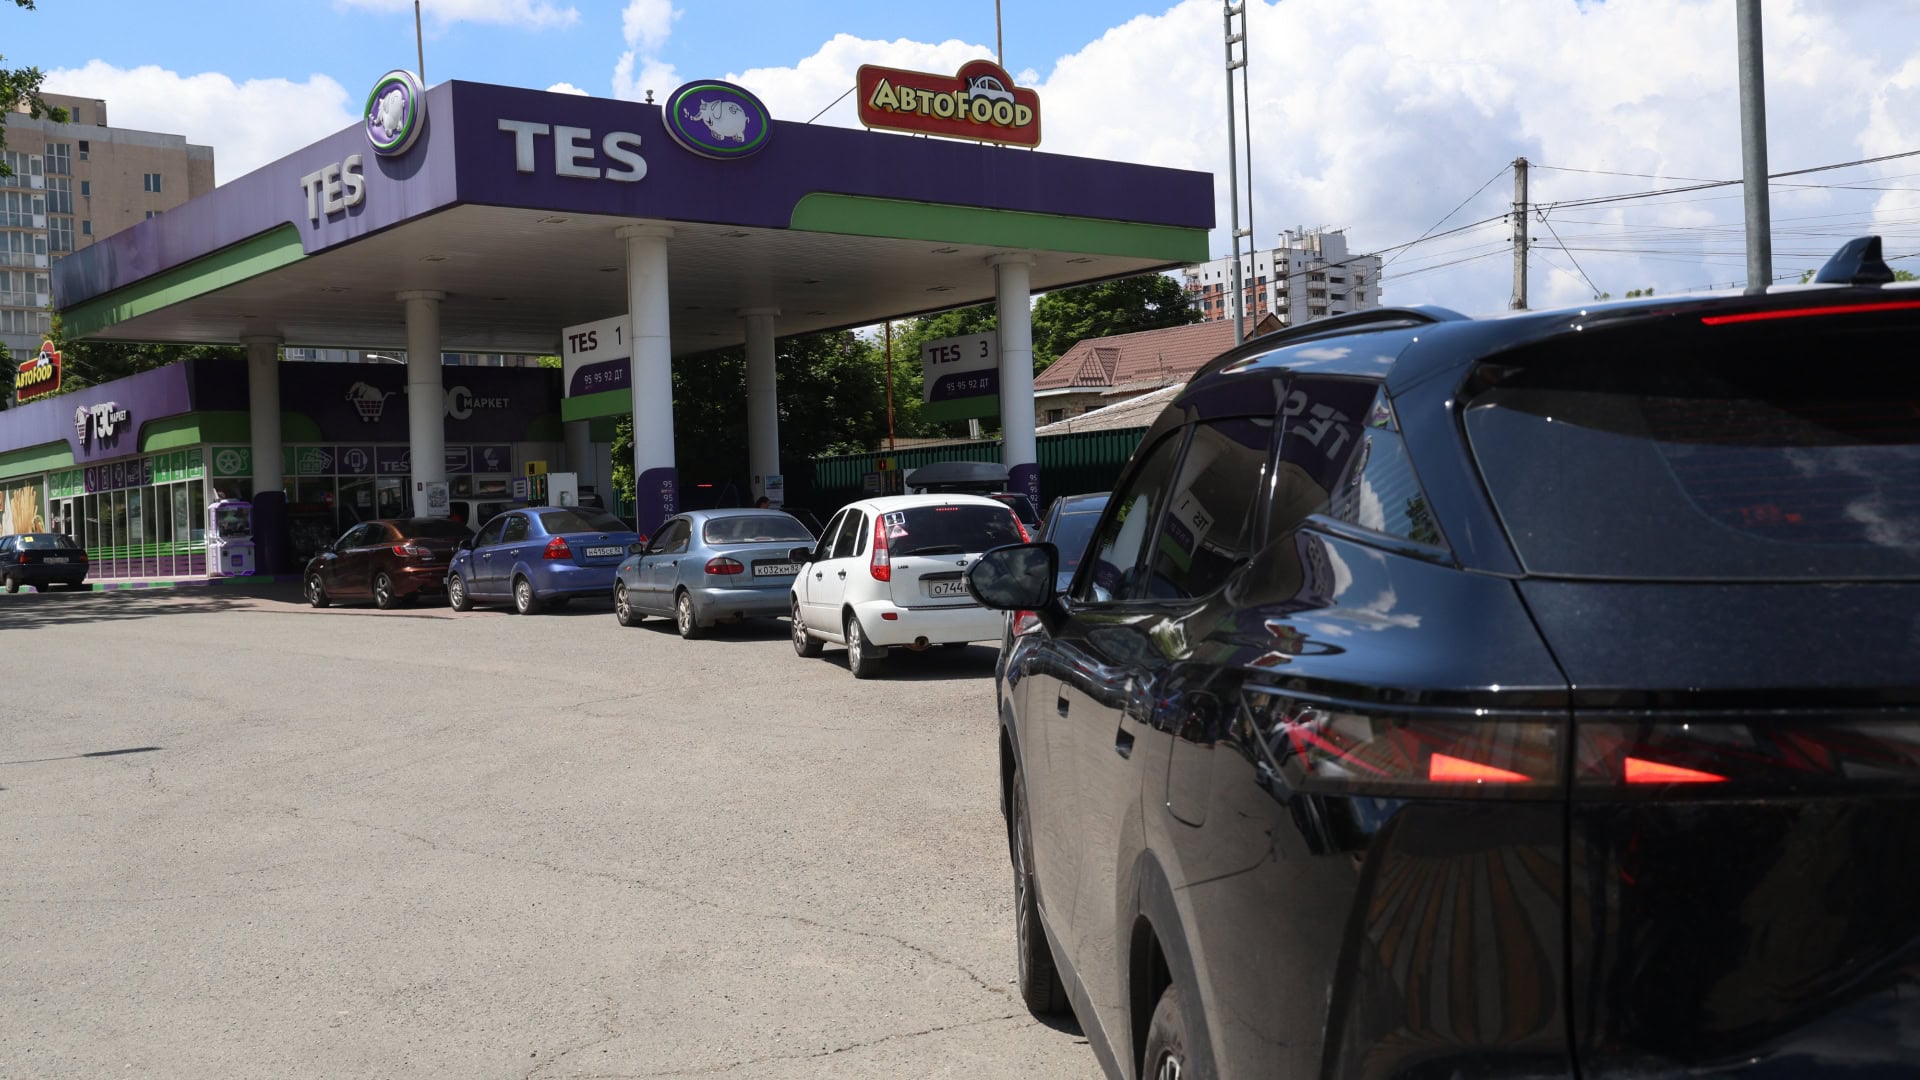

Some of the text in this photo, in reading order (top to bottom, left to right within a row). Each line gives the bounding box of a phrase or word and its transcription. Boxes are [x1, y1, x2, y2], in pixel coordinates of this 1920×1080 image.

[497, 118, 648, 182] TES
[301, 154, 366, 222] TES
[569, 325, 622, 354] TES 1
[928, 340, 989, 365] TES 3
[584, 368, 623, 385] 95 95 92 ДТ
[463, 398, 510, 408] МАРКЕТ
[662, 480, 673, 488] 95
[663, 503, 674, 511] 92
